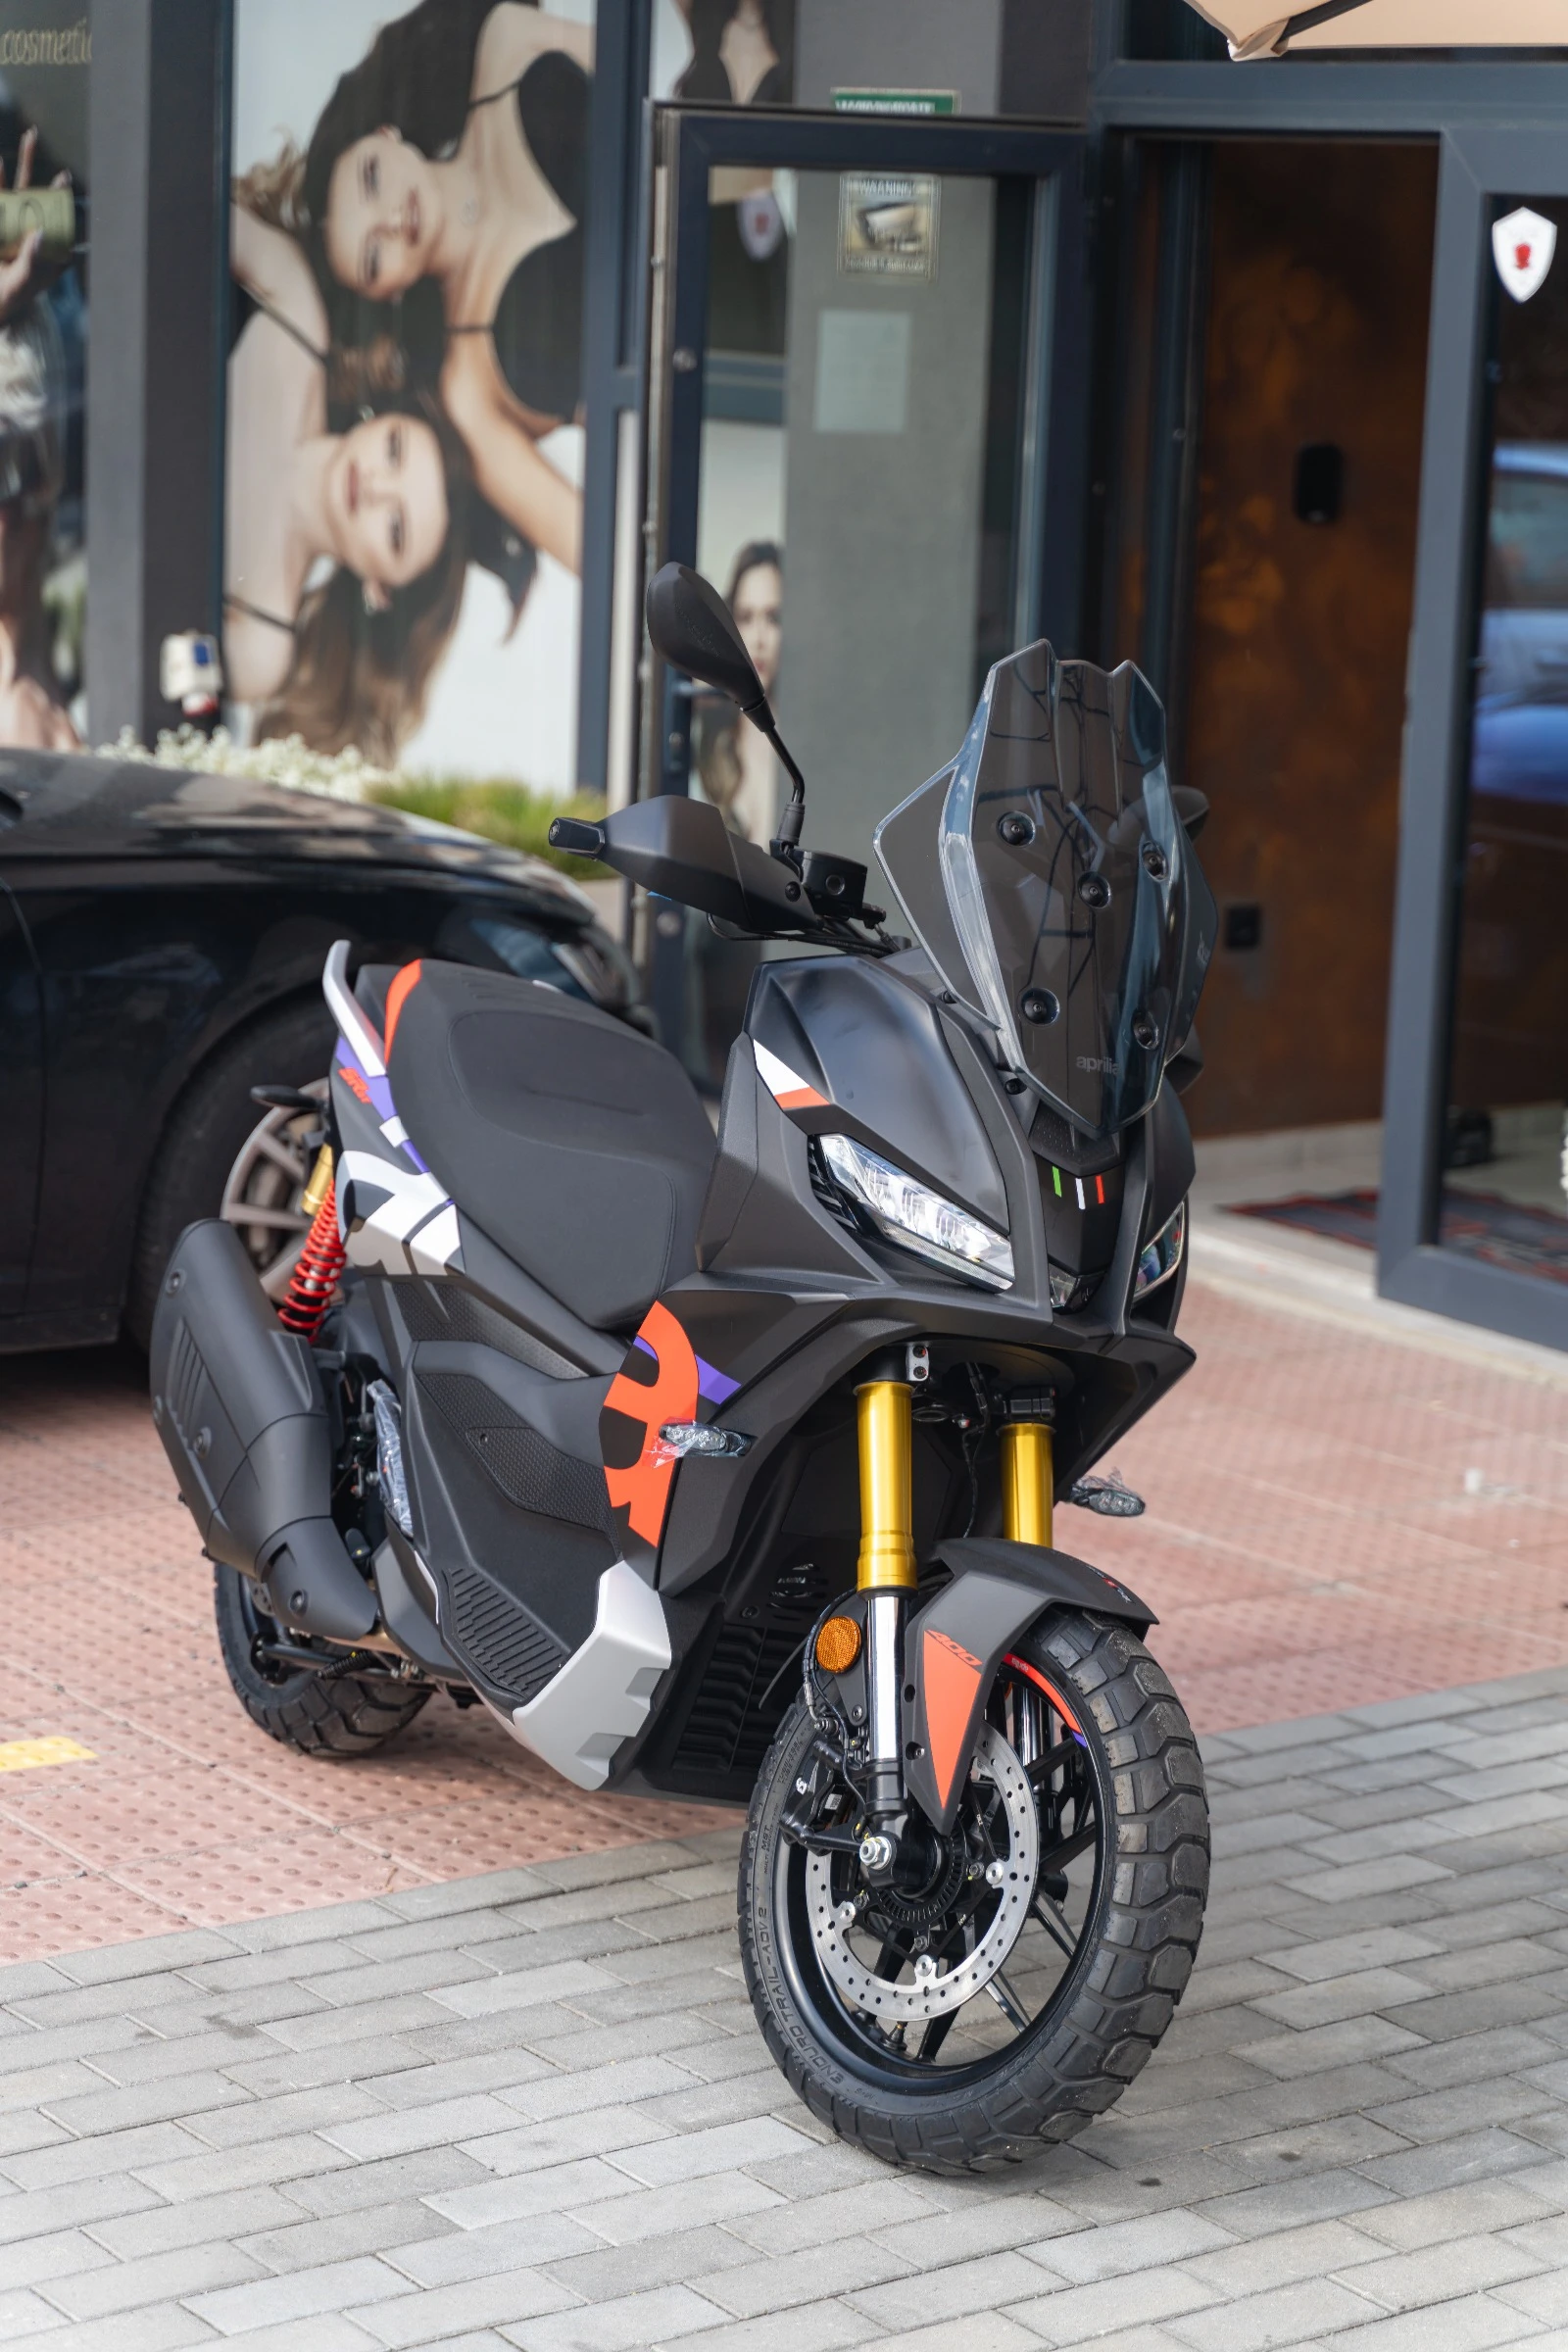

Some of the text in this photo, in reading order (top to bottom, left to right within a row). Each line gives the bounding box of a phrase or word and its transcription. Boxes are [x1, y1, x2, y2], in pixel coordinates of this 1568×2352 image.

[1075, 1055, 1119, 1074] aprilia
[926, 1629, 983, 1666] 400
[791, 2024, 844, 2084] ENDURO
